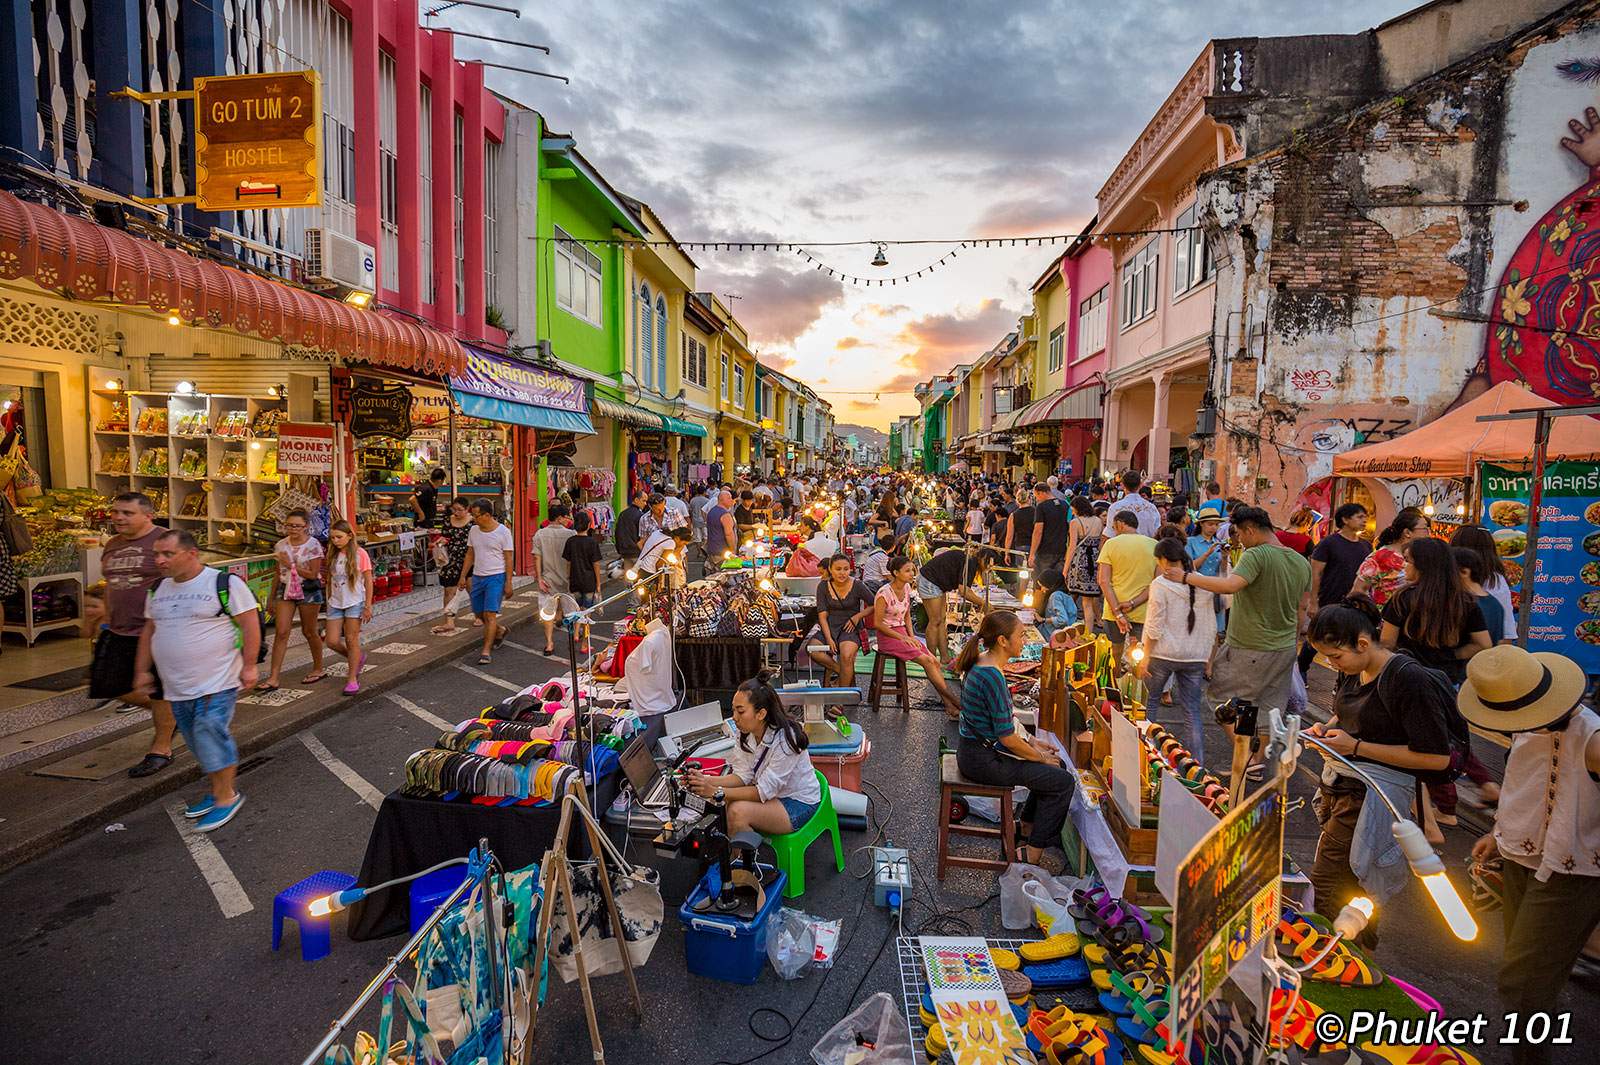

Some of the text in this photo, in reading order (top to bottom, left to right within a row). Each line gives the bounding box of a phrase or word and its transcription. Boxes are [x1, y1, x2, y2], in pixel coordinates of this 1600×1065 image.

[211, 96, 303, 124] GO TUM 2
[224, 146, 289, 168] HOSTEL
[357, 398, 390, 408] GOTUM
[280, 440, 333, 452] MONEY
[279, 451, 333, 464] EXCHANGE
[1409, 456, 1432, 474] Shop
